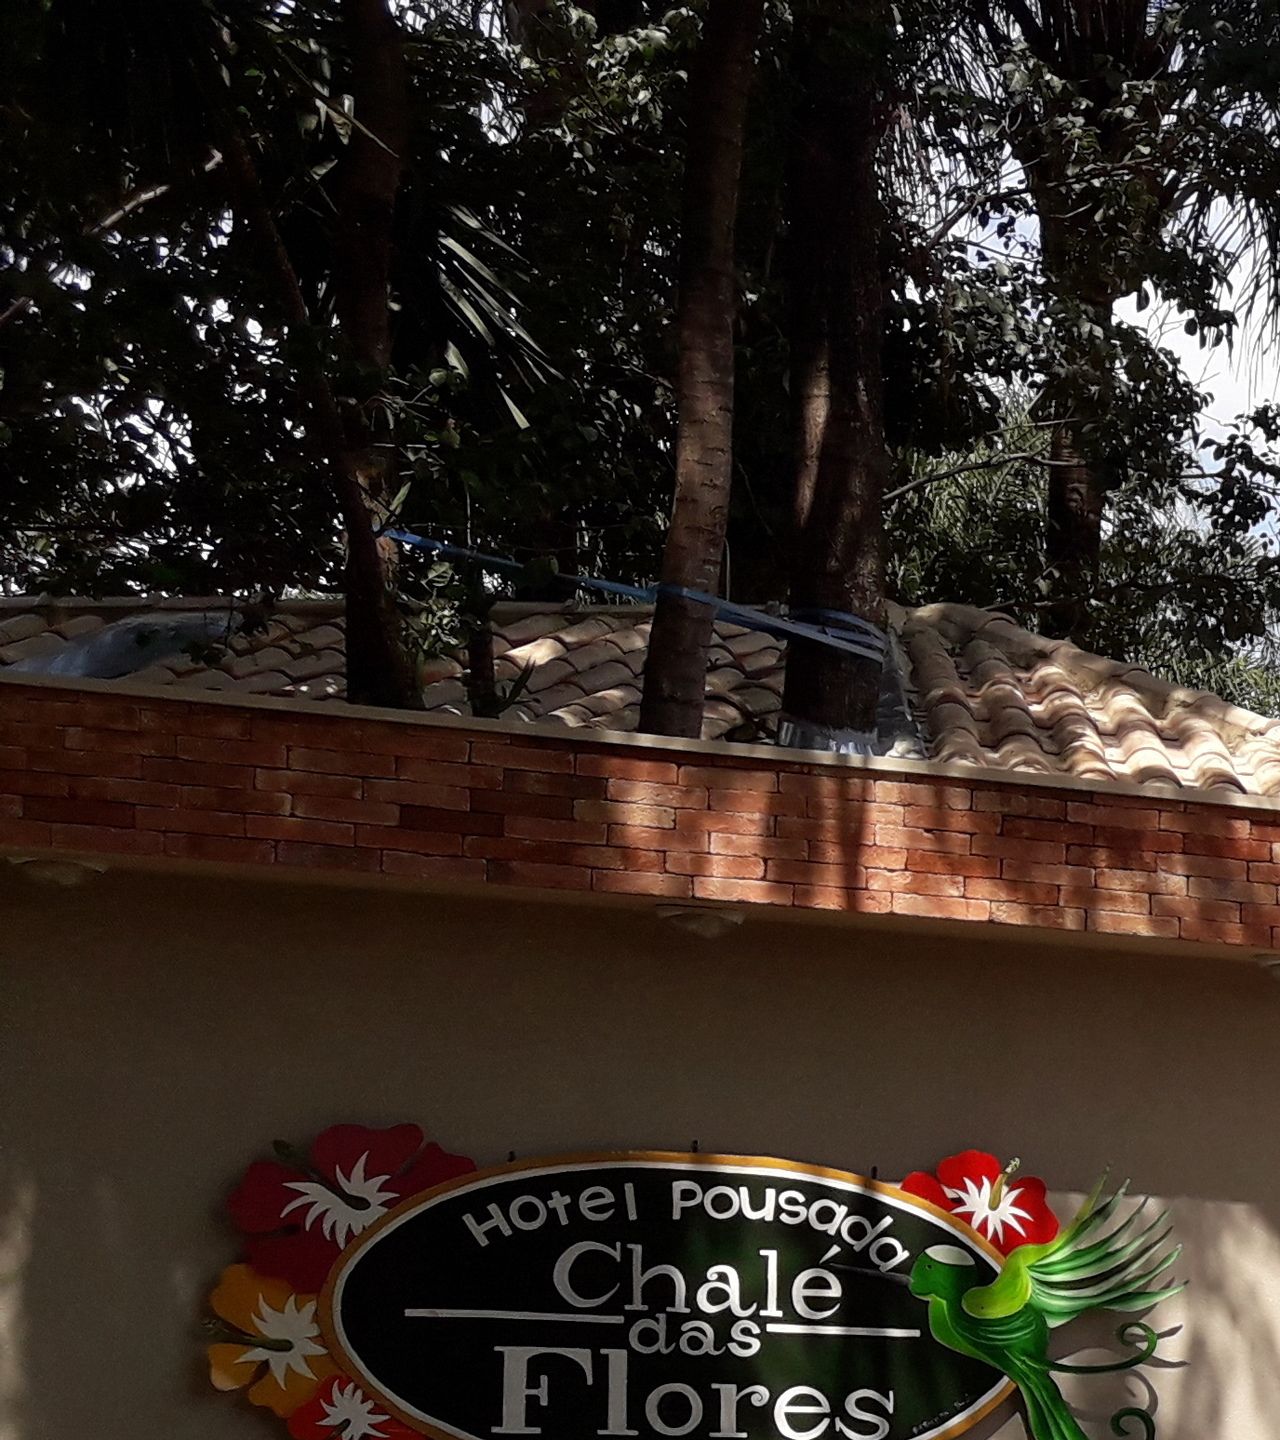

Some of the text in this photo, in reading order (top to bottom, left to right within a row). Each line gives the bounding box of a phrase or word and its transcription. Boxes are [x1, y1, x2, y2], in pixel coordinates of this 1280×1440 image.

[462, 1181, 910, 1272] Hotel Pousada
[553, 1240, 844, 1320] Chalé
[628, 1313, 762, 1358] das
